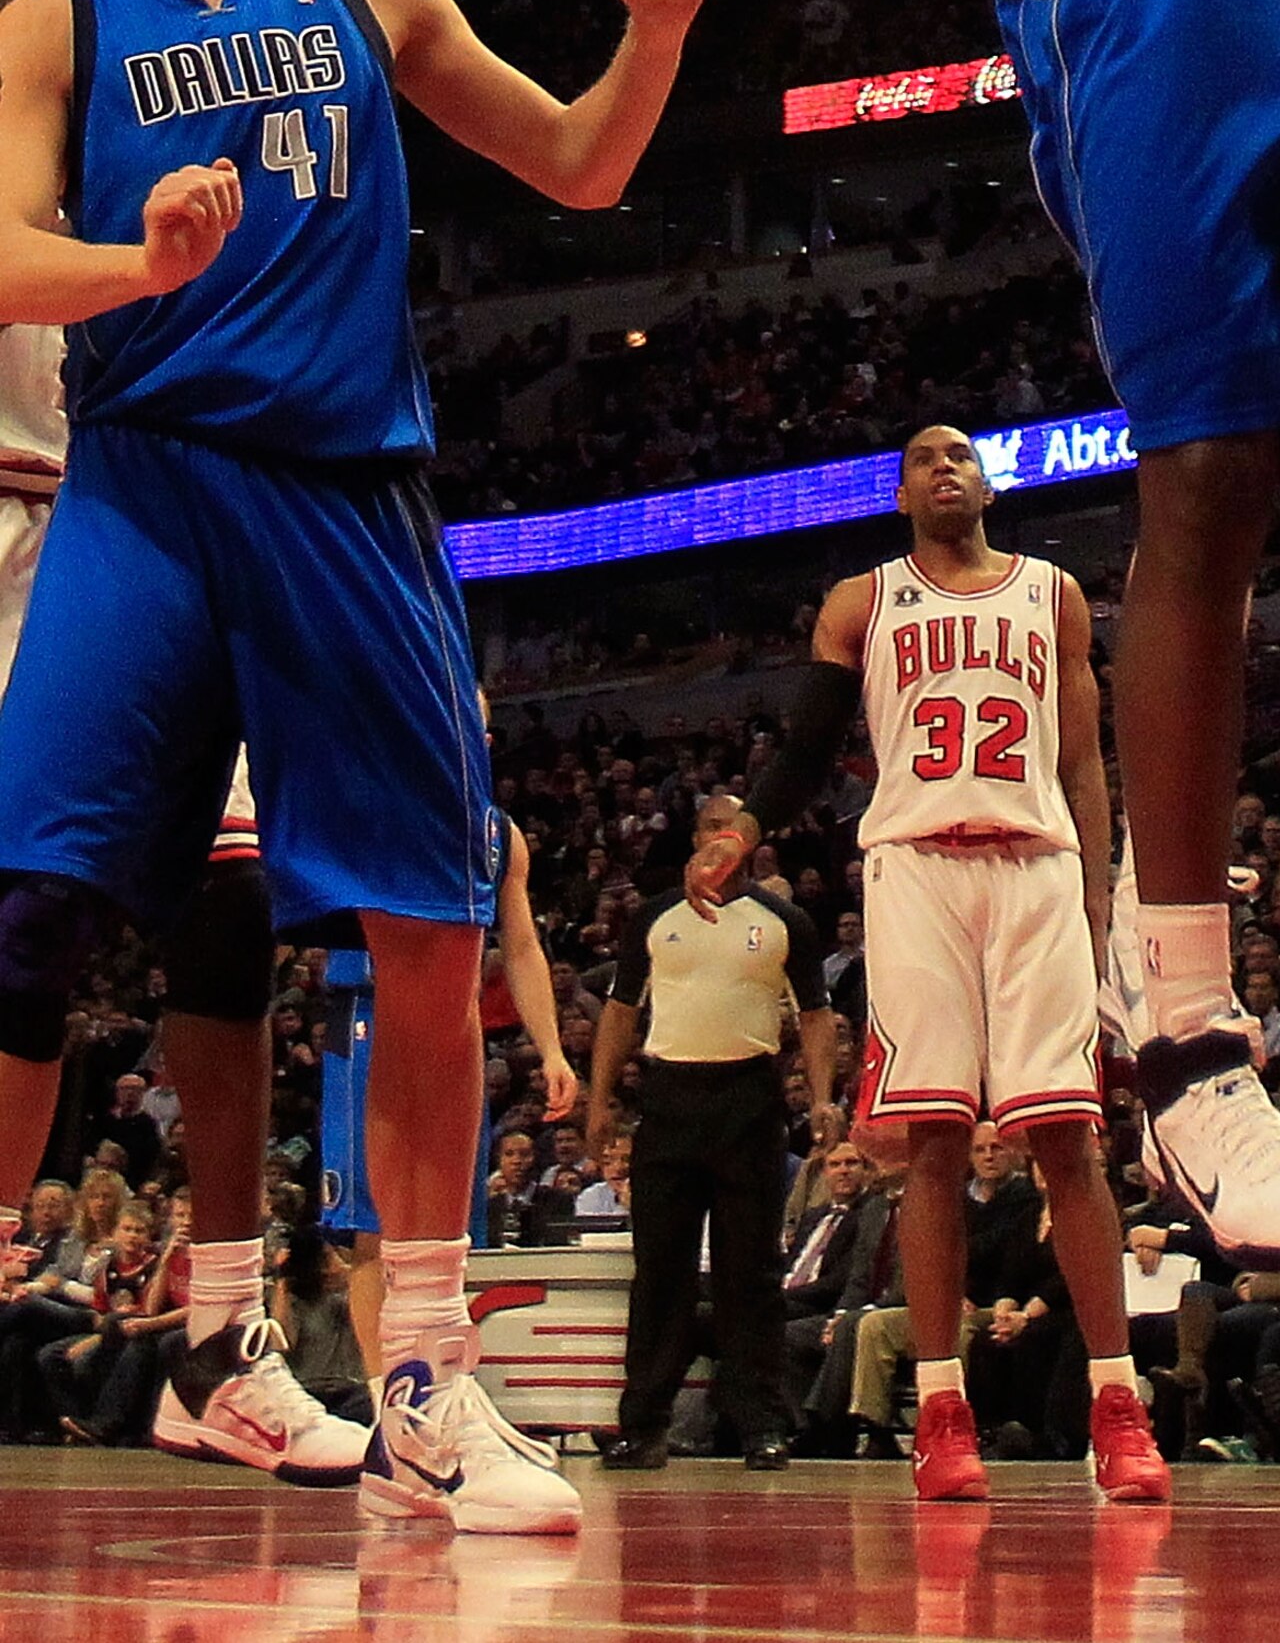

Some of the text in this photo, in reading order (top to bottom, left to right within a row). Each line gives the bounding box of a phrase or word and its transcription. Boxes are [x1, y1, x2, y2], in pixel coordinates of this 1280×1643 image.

[124, 25, 346, 126] DALLAS
[262, 105, 349, 200] 41
[893, 615, 1048, 702] BULLS
[912, 695, 1029, 783] 32
